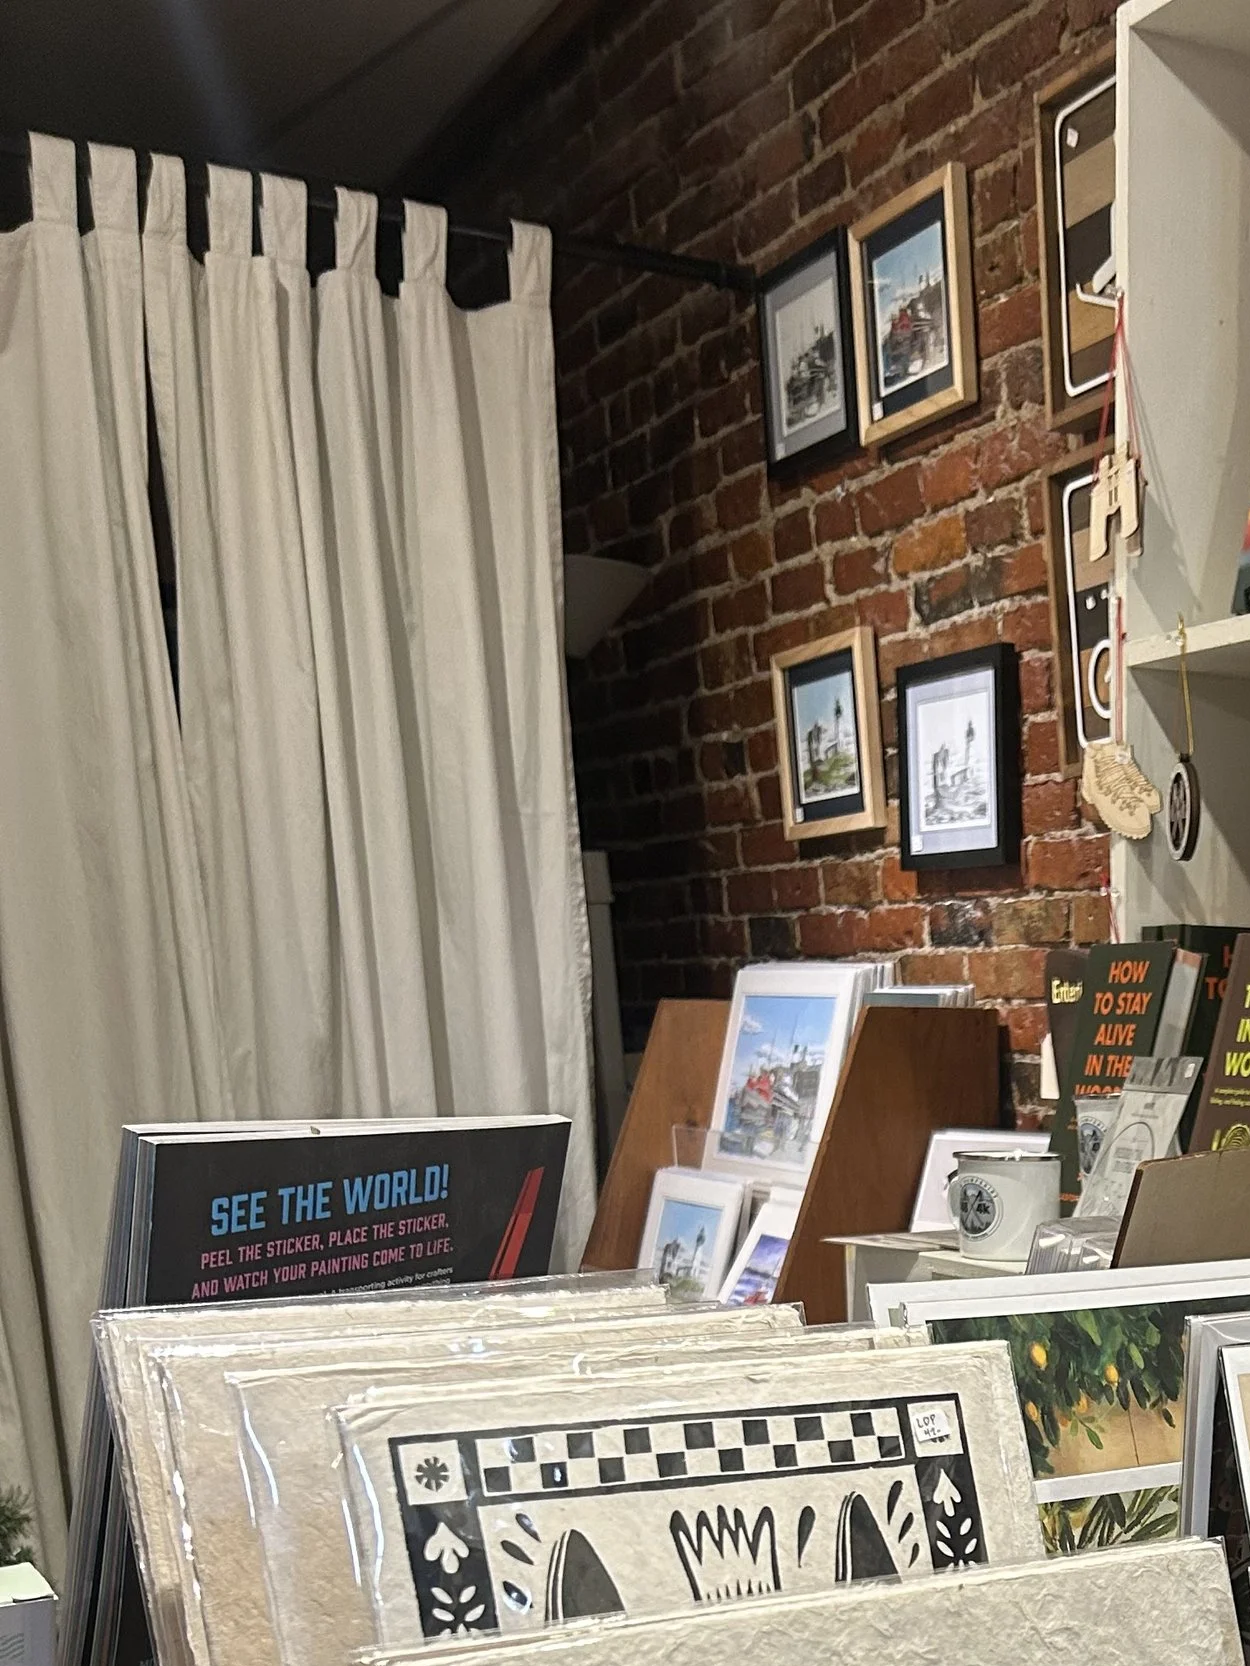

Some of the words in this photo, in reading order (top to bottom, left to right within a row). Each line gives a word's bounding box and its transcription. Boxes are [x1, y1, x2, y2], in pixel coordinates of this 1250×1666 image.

[1108, 960, 1149, 984] HOW
[1093, 992, 1114, 1015] TO
[1116, 992, 1153, 1016] STAY
[1094, 1023, 1136, 1046] ALIVE
[1084, 1055, 1105, 1076] IN
[1105, 1055, 1132, 1077] THE
[211, 1191, 268, 1236] SEE
[278, 1181, 333, 1225] THE
[343, 1164, 450, 1215] WORLD!
[201, 1249, 233, 1270] PEEL
[238, 1243, 262, 1264] THE
[266, 1233, 324, 1257] STICKER,
[328, 1226, 368, 1248] PLACE
[372, 1221, 395, 1240] THE
[398, 1213, 450, 1236] STICKER,
[191, 1279, 219, 1300] AND
[223, 1270, 268, 1294] WATCH
[273, 1264, 306, 1284] YOUR
[310, 1253, 369, 1278] PAINTING
[373, 1246, 405, 1268] COME
[409, 1243, 424, 1258] TO
[427, 1237, 454, 1256] LIFE.
[387, 1274, 414, 1287] activity
[415, 1272, 426, 1281] for
[426, 1266, 453, 1279] crafters
